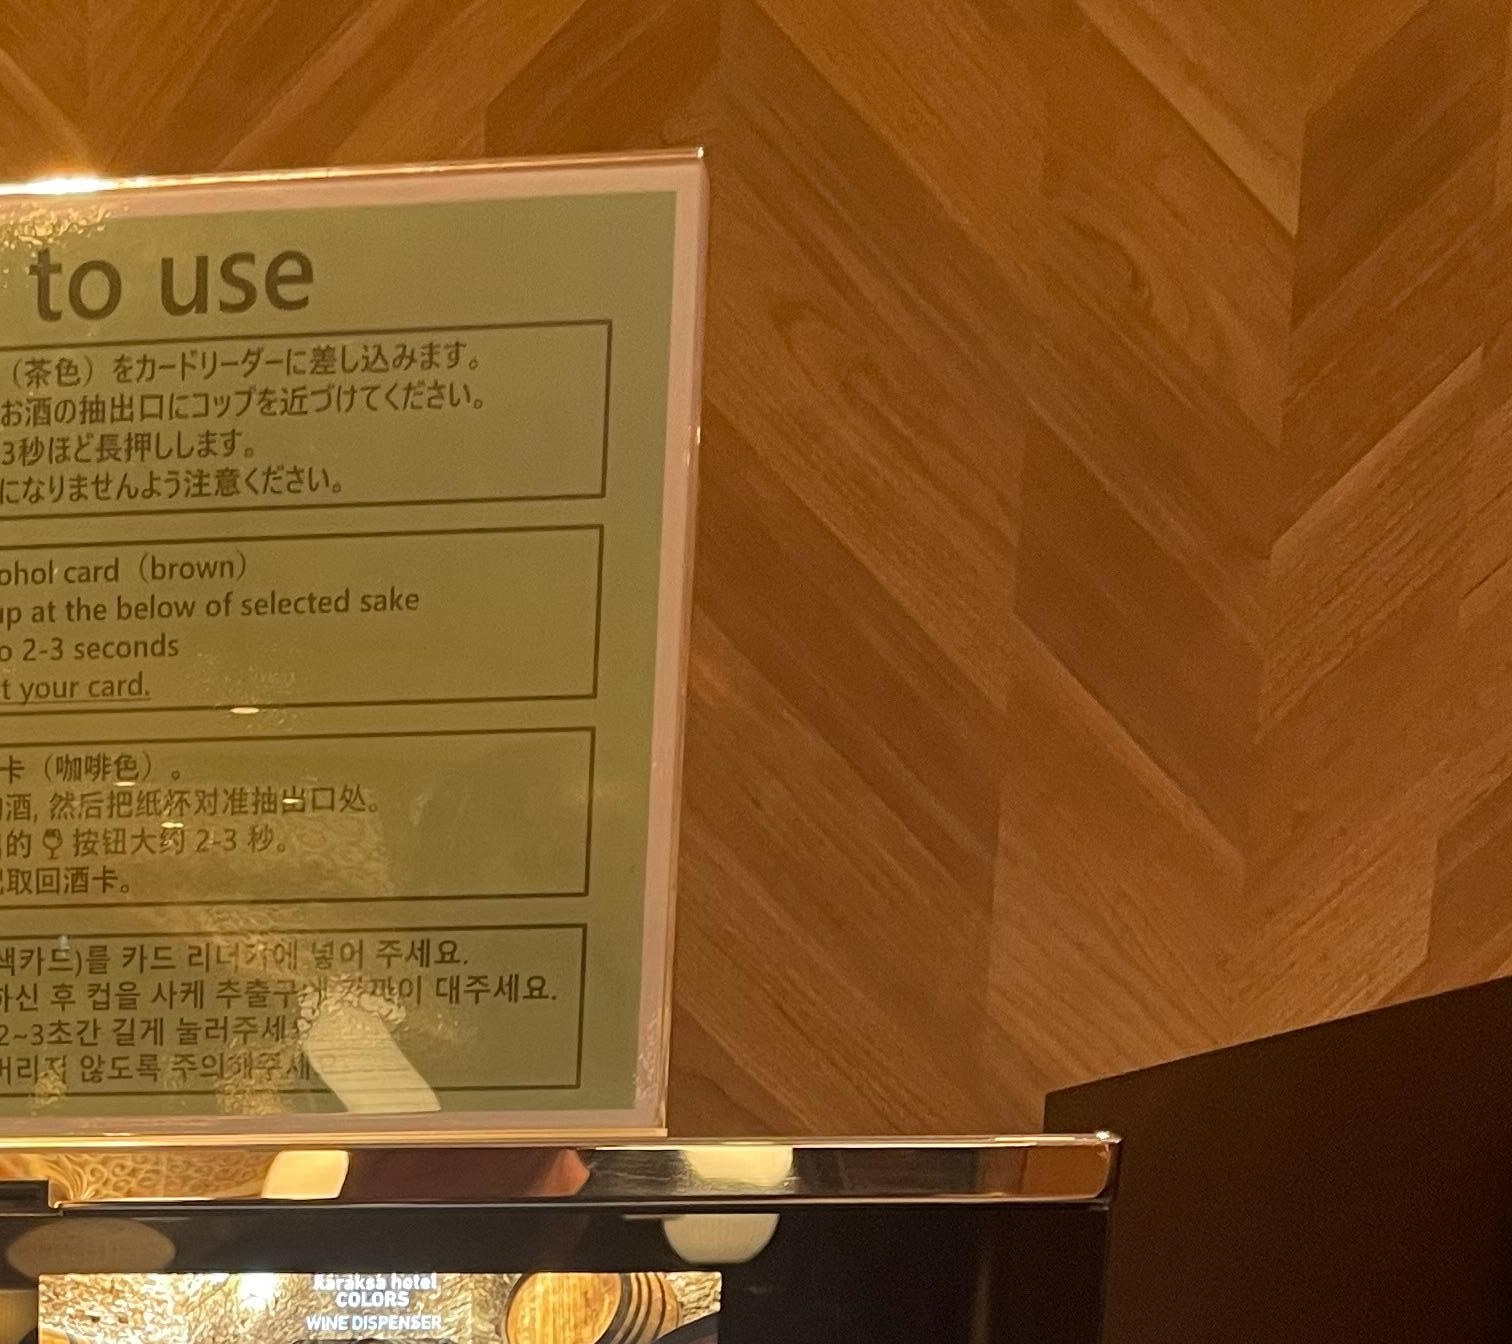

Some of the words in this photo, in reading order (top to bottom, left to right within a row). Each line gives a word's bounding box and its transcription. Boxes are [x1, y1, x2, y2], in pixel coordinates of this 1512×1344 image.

[29, 248, 122, 321] to
[160, 247, 315, 317] use
[63, 558, 119, 584] card
[32, 602, 56, 624] at
[66, 597, 107, 622] the
[117, 596, 195, 620] below
[206, 591, 233, 616] of
[241, 588, 349, 616] selected
[360, 586, 419, 612] sake
[22, 636, 64, 661] 2-3
[74, 633, 179, 659] seconds
[20, 678, 79, 706] your
[89, 672, 150, 698] card.
[122, 944, 176, 975] 카드
[376, 939, 467, 968] 주세요.
[437, 973, 557, 1003] 대주세요.
[80, 1054, 161, 1085] 않도록
[313, 1273, 385, 1290] karaksa
[391, 1273, 437, 1290] hotel
[335, 1291, 409, 1307] COLORS
[306, 1315, 348, 1330] WINE
[352, 1315, 441, 1330] DISPENSER
